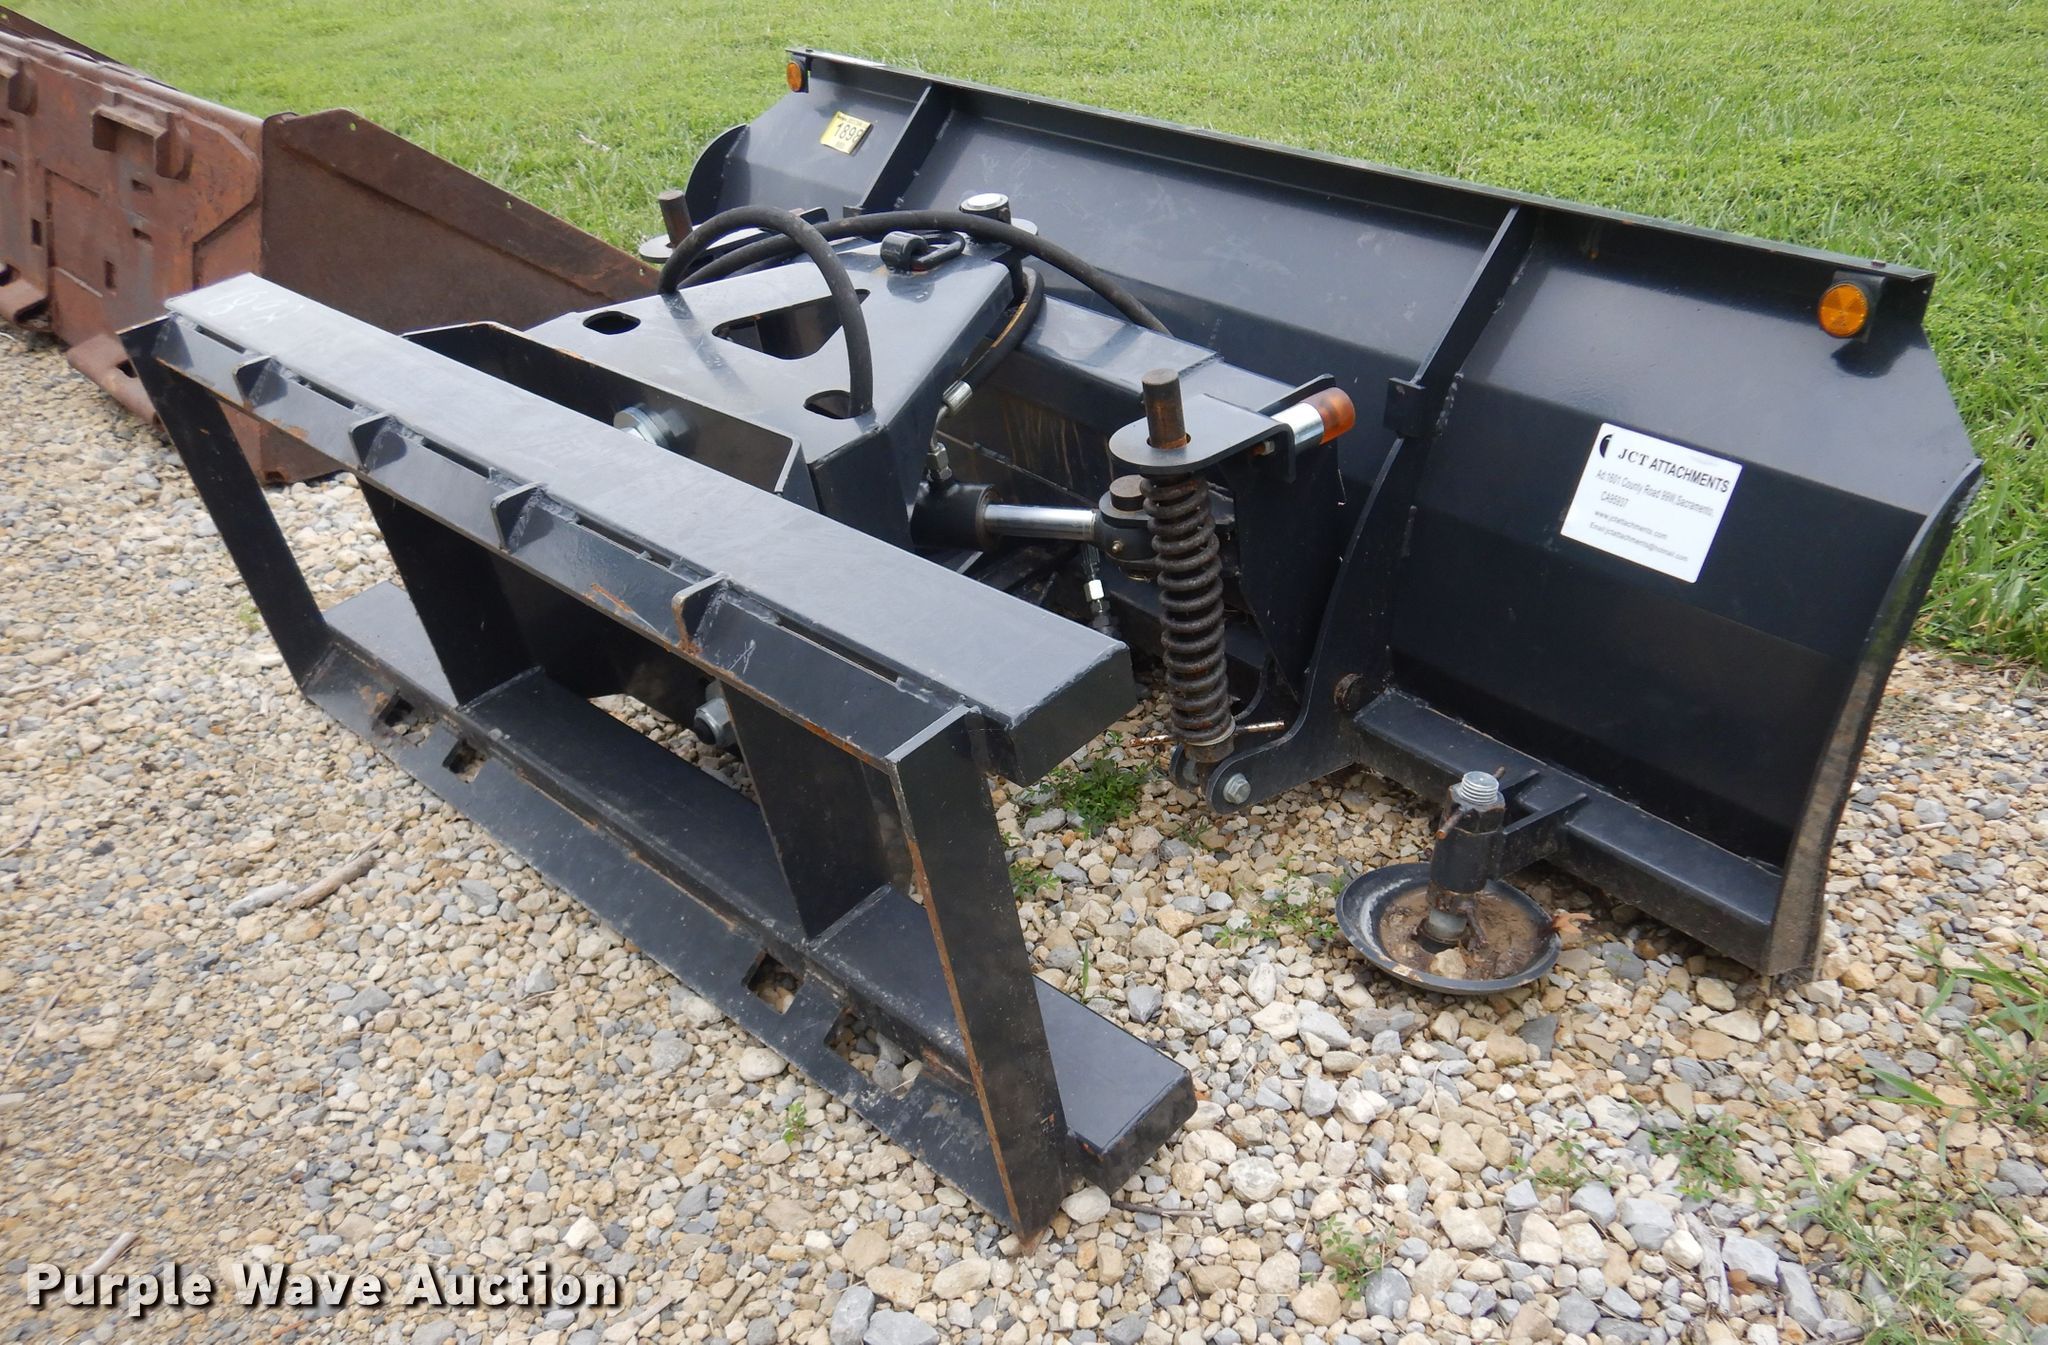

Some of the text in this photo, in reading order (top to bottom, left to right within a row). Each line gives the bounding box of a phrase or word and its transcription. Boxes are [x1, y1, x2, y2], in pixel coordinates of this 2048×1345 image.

[1617, 448, 1730, 493] JCT ATTACHMENTS
[1622, 477, 1643, 496] County
[1644, 484, 1661, 500] Road
